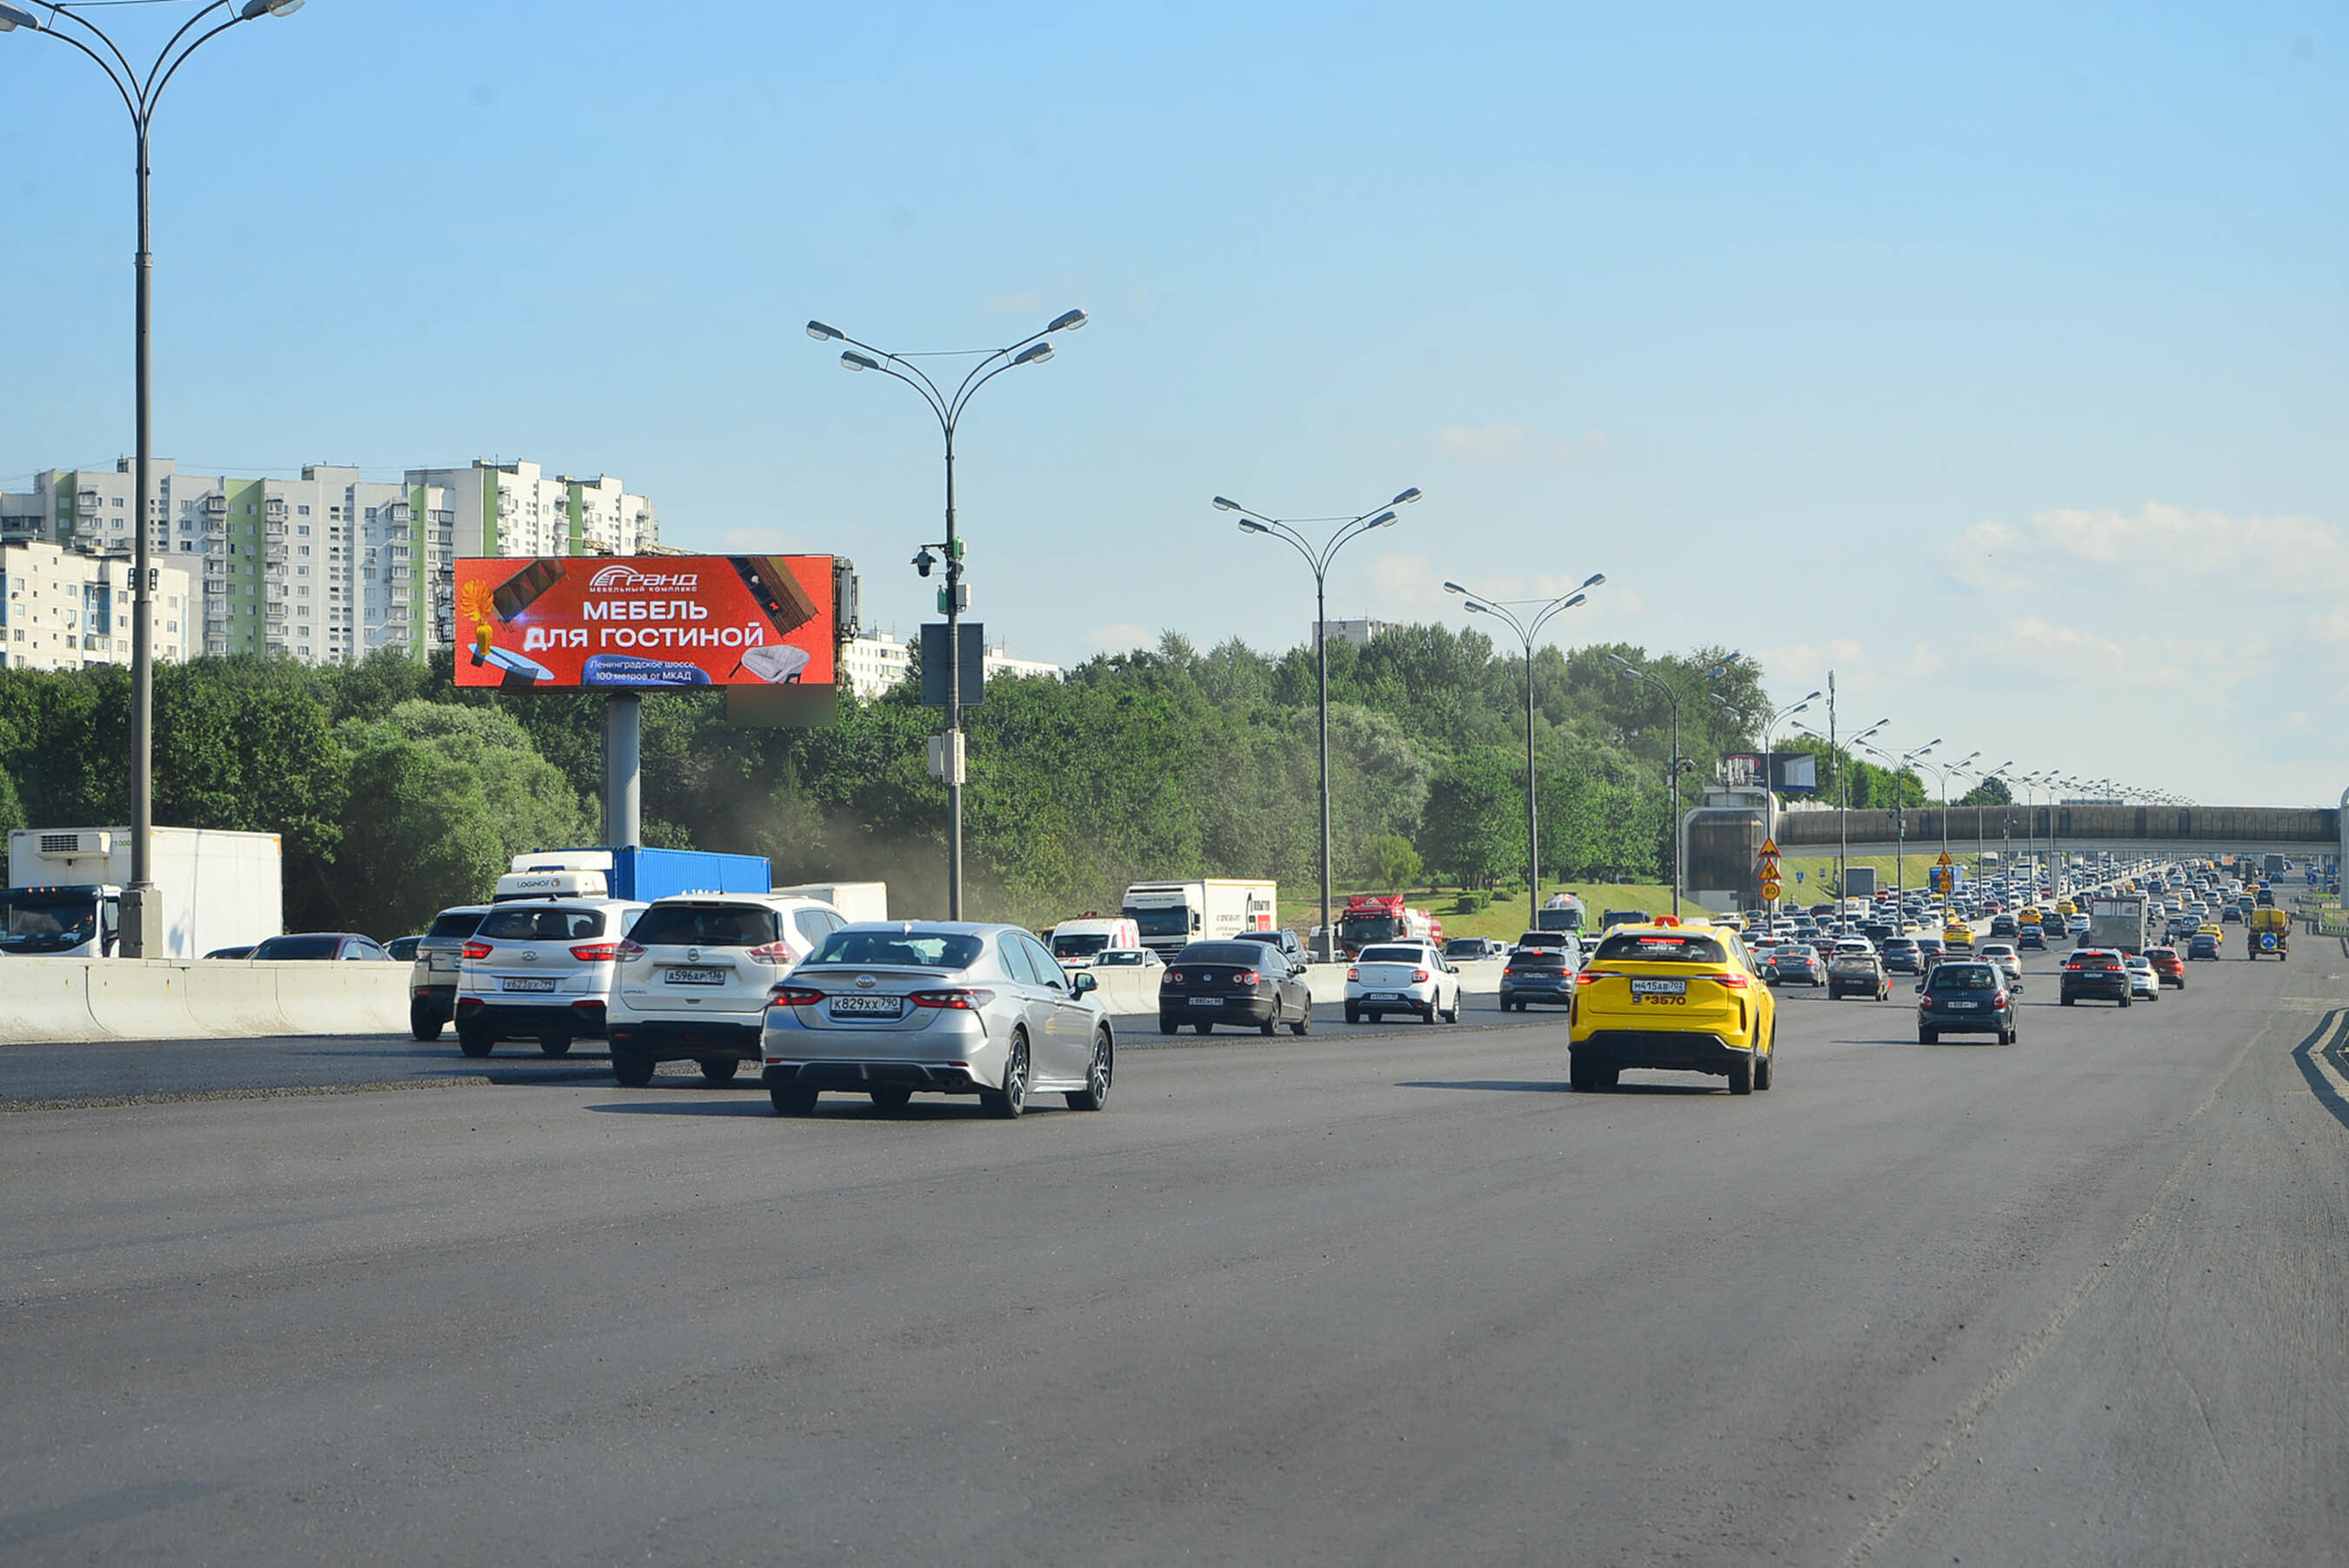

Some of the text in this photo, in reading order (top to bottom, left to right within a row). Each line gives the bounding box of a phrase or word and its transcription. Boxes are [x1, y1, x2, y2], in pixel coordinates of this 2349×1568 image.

[584, 601, 708, 620] МЕБЕЛЬ
[524, 622, 764, 651] ДЛЯ ГОСТИНОЙ
[590, 660, 663, 670] Ленинградское
[614, 673, 648, 682] метров
[663, 671, 691, 681] МКАД
